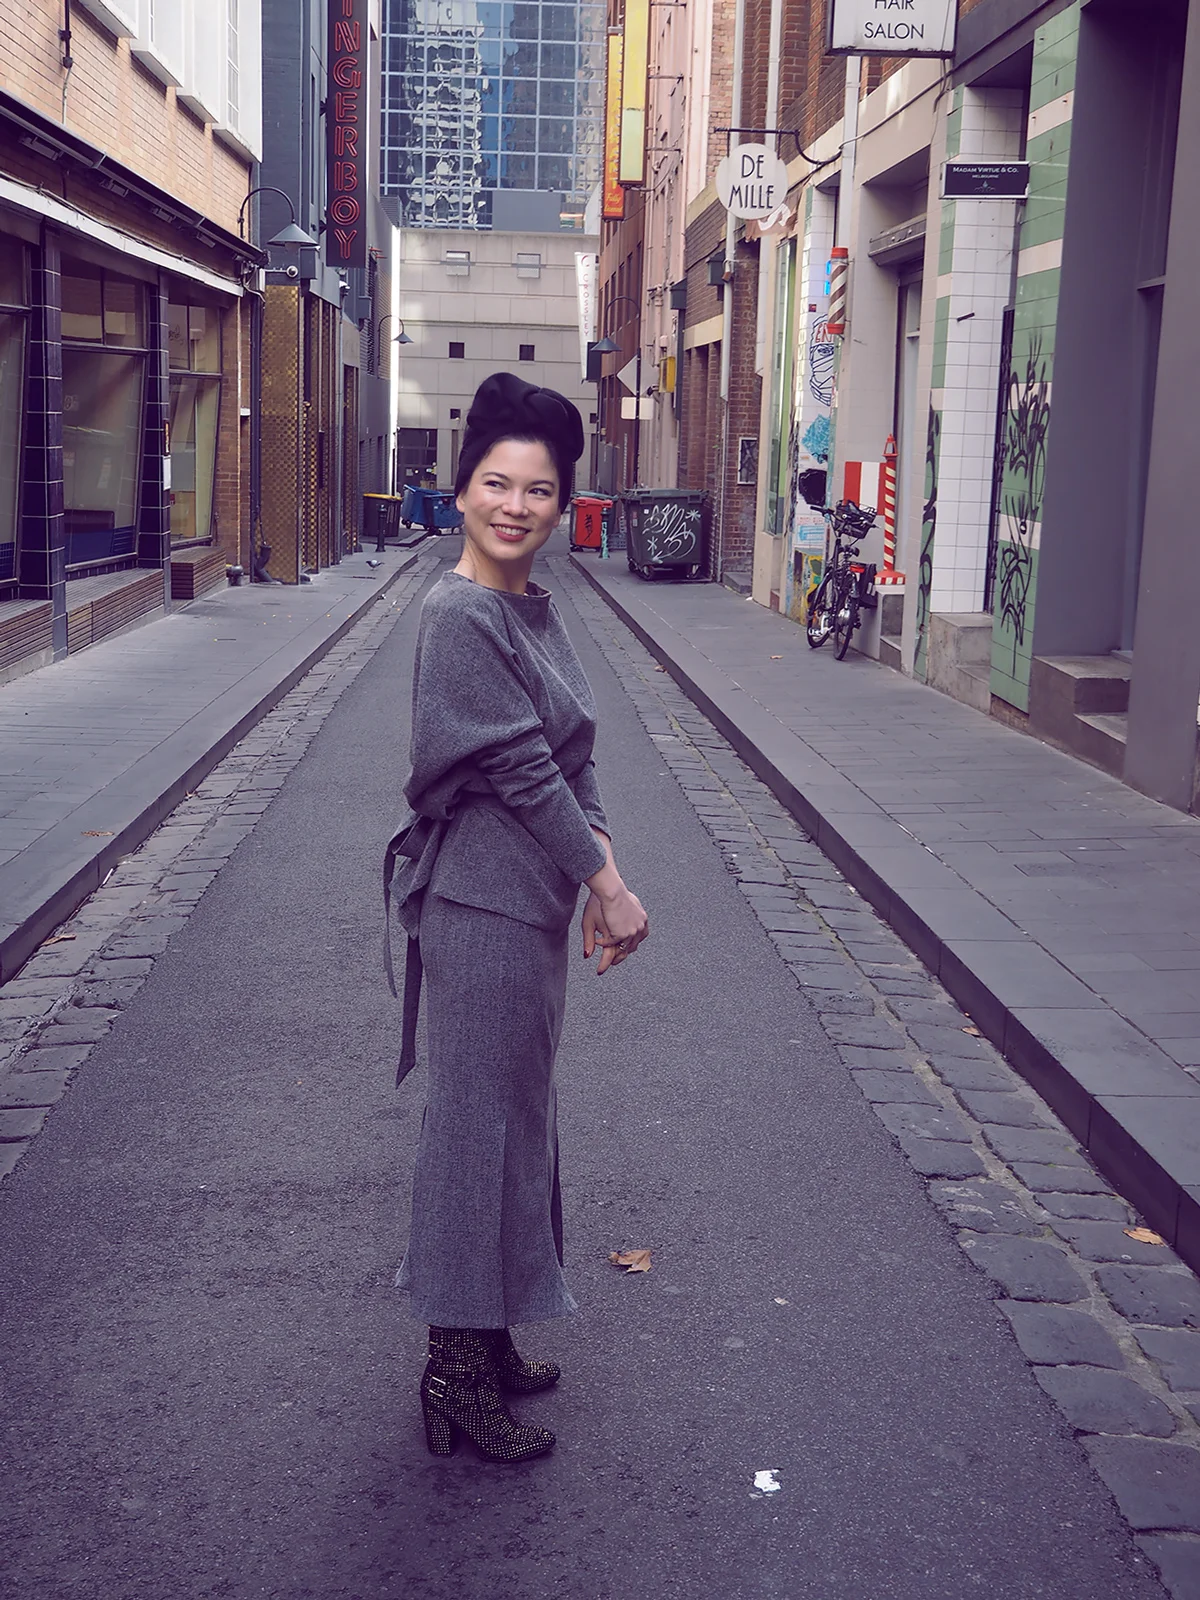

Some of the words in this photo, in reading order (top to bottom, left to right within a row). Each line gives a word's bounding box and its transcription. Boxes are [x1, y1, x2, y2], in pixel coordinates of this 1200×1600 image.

[874, 0, 915, 10] HAIR
[864, 22, 924, 39] SALON
[741, 154, 764, 179] DE
[728, 185, 774, 209] MILLE
